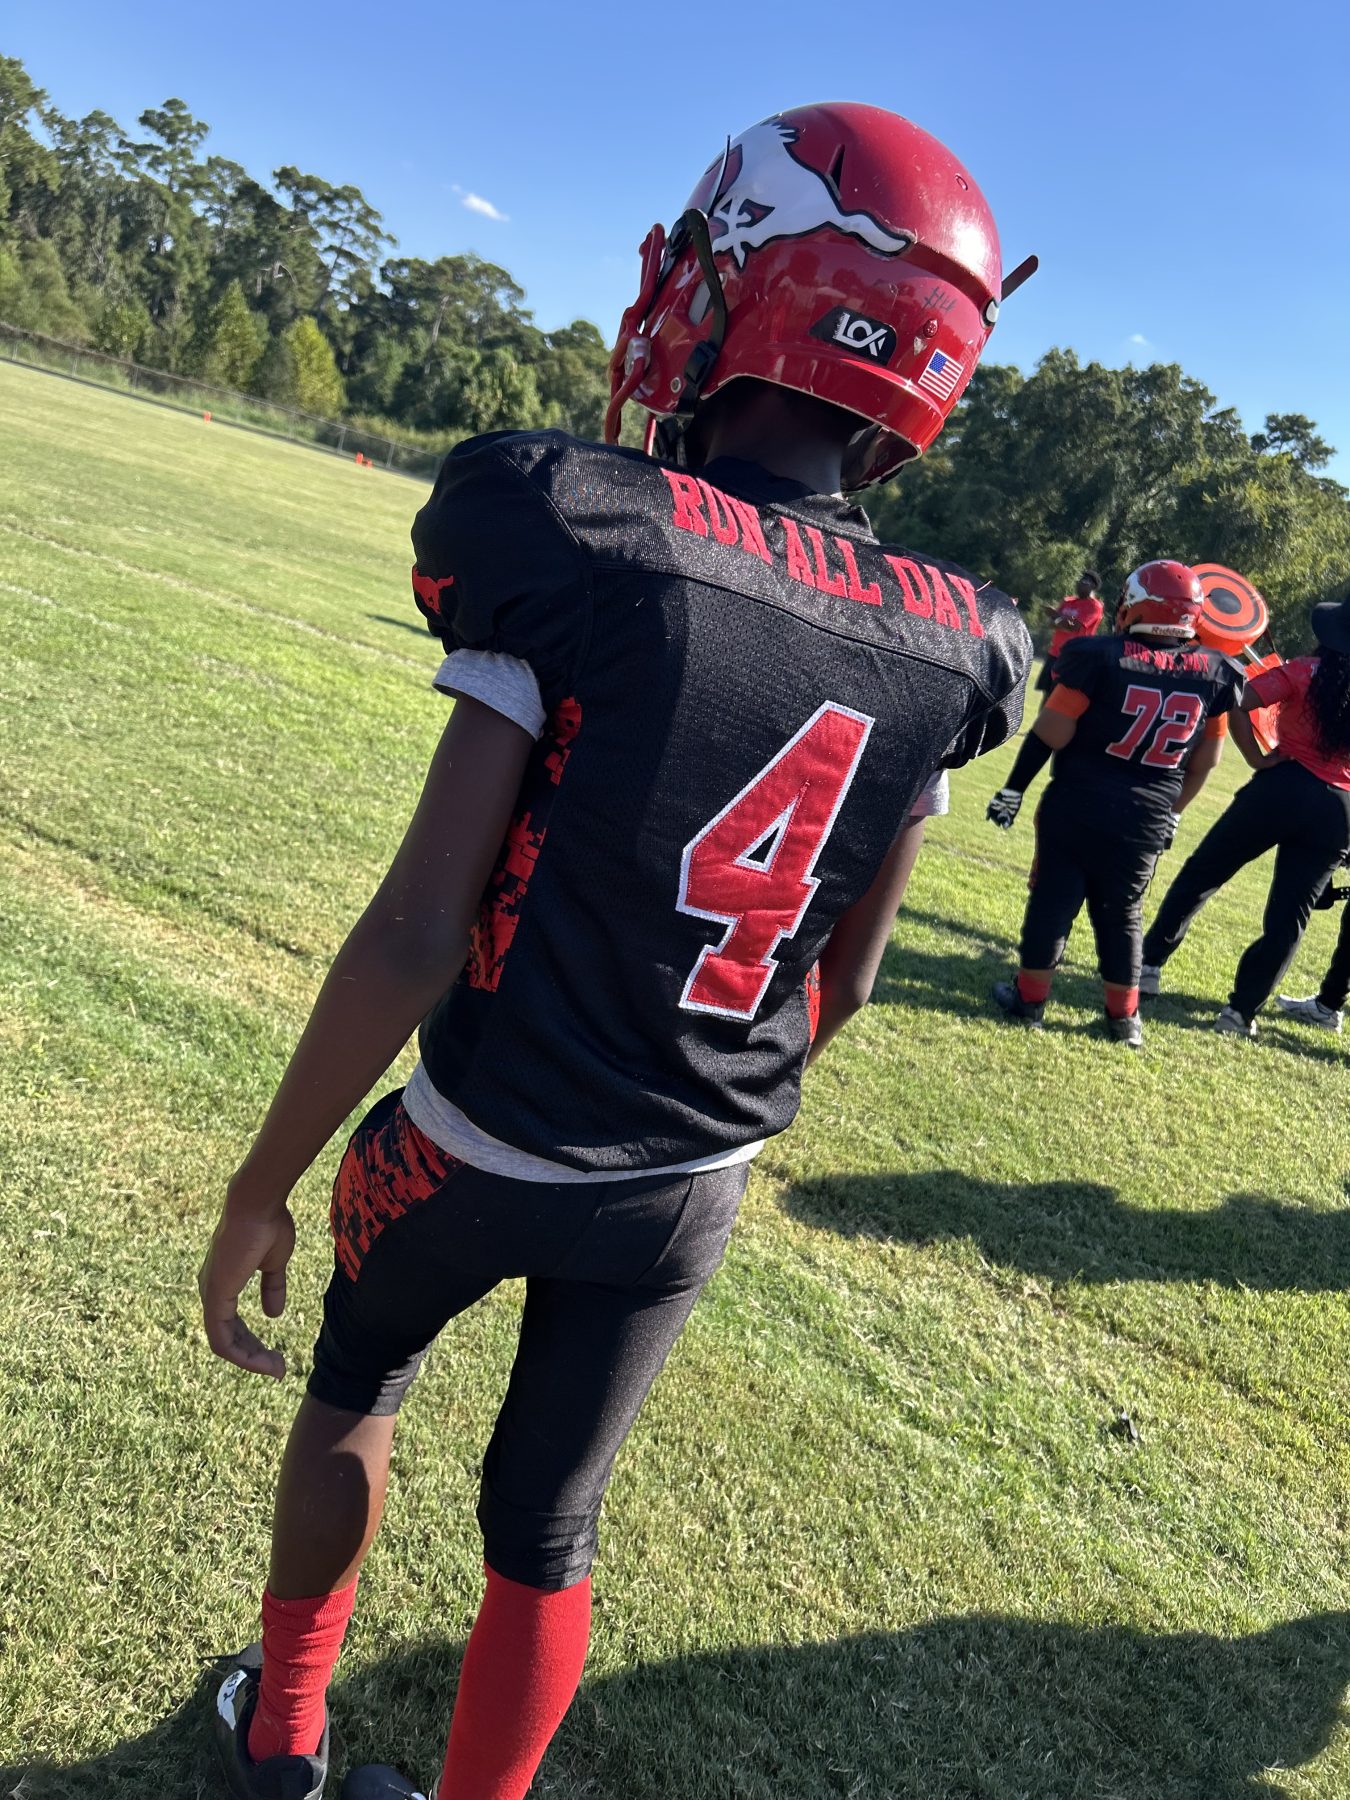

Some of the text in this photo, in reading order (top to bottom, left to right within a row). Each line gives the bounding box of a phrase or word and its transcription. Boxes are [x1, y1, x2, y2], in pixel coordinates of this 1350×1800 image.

[832, 311, 888, 357] LOX
[660, 467, 986, 639] RUN ALL DAY
[1105, 684, 1203, 769] 72
[675, 699, 875, 1022] 4
